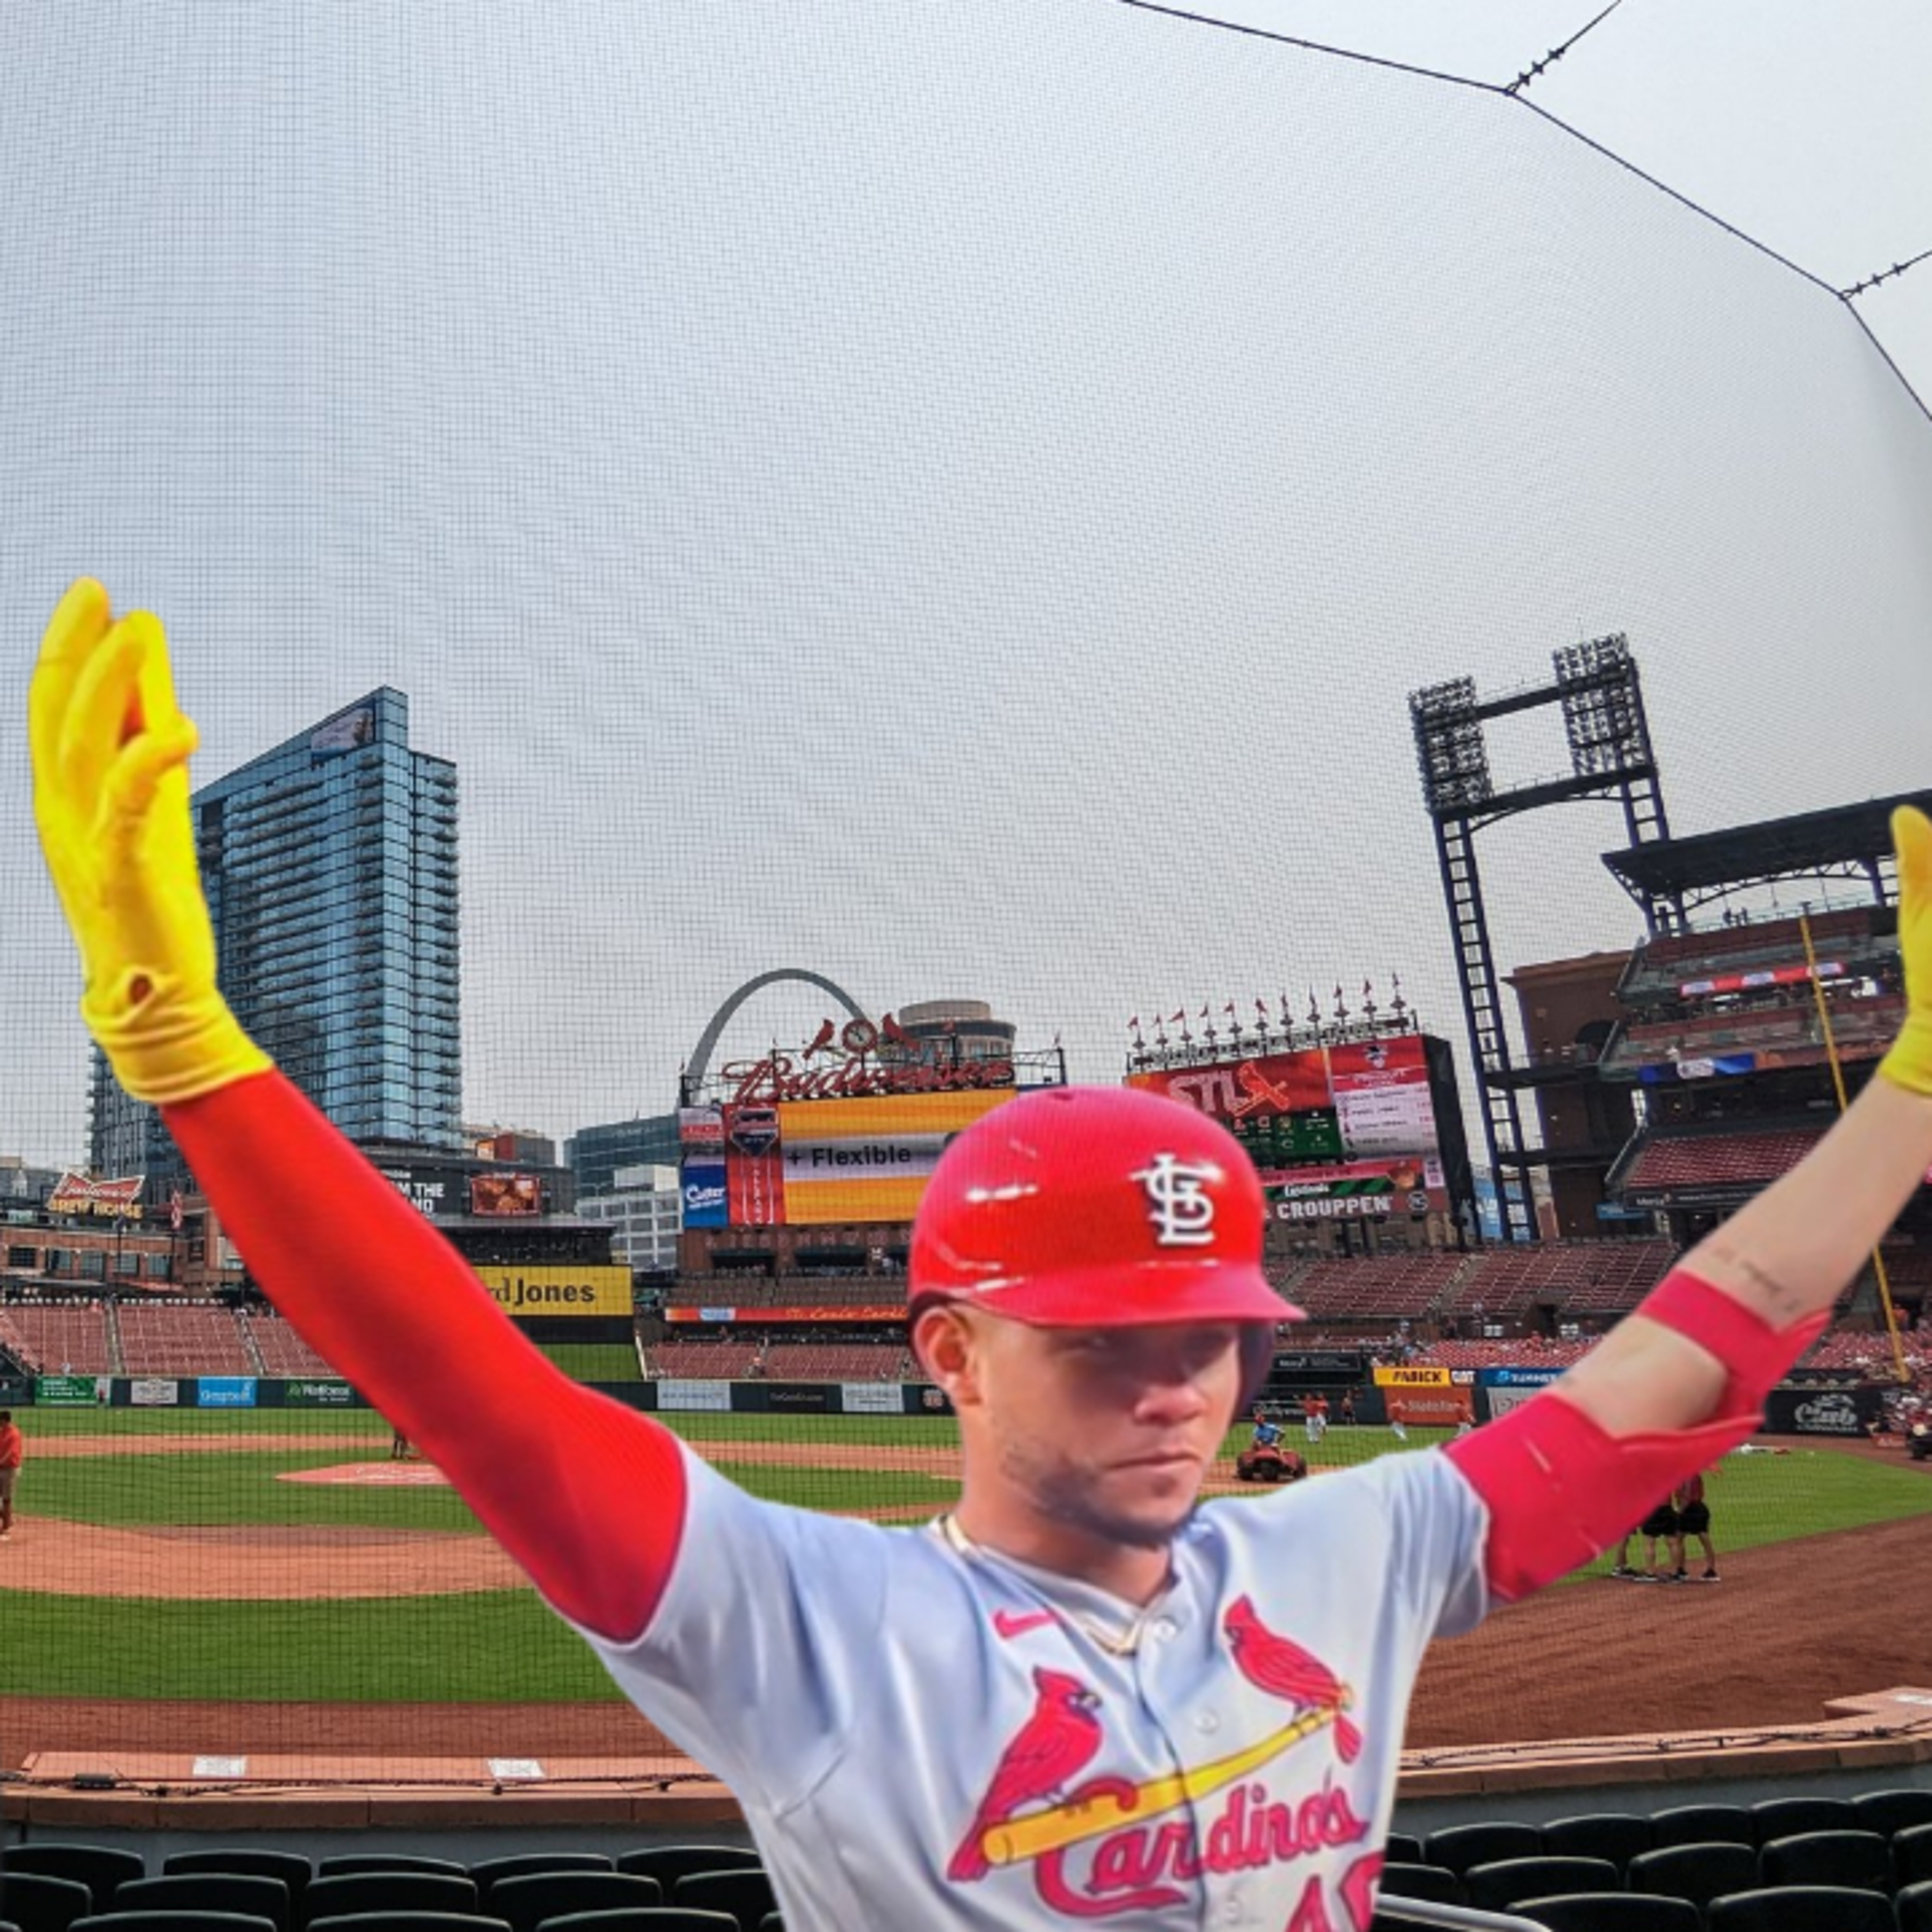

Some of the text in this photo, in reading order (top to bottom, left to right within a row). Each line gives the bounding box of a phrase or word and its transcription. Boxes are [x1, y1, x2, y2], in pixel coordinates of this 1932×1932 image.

[1168, 1070, 1251, 1113] STL
[811, 1145, 911, 1167] Flexible
[414, 1182, 446, 1198] THE
[1277, 1196, 1390, 1219] CROUPPEN
[514, 1275, 595, 1307] Jones
[1392, 1370, 1442, 1383] FABICK
